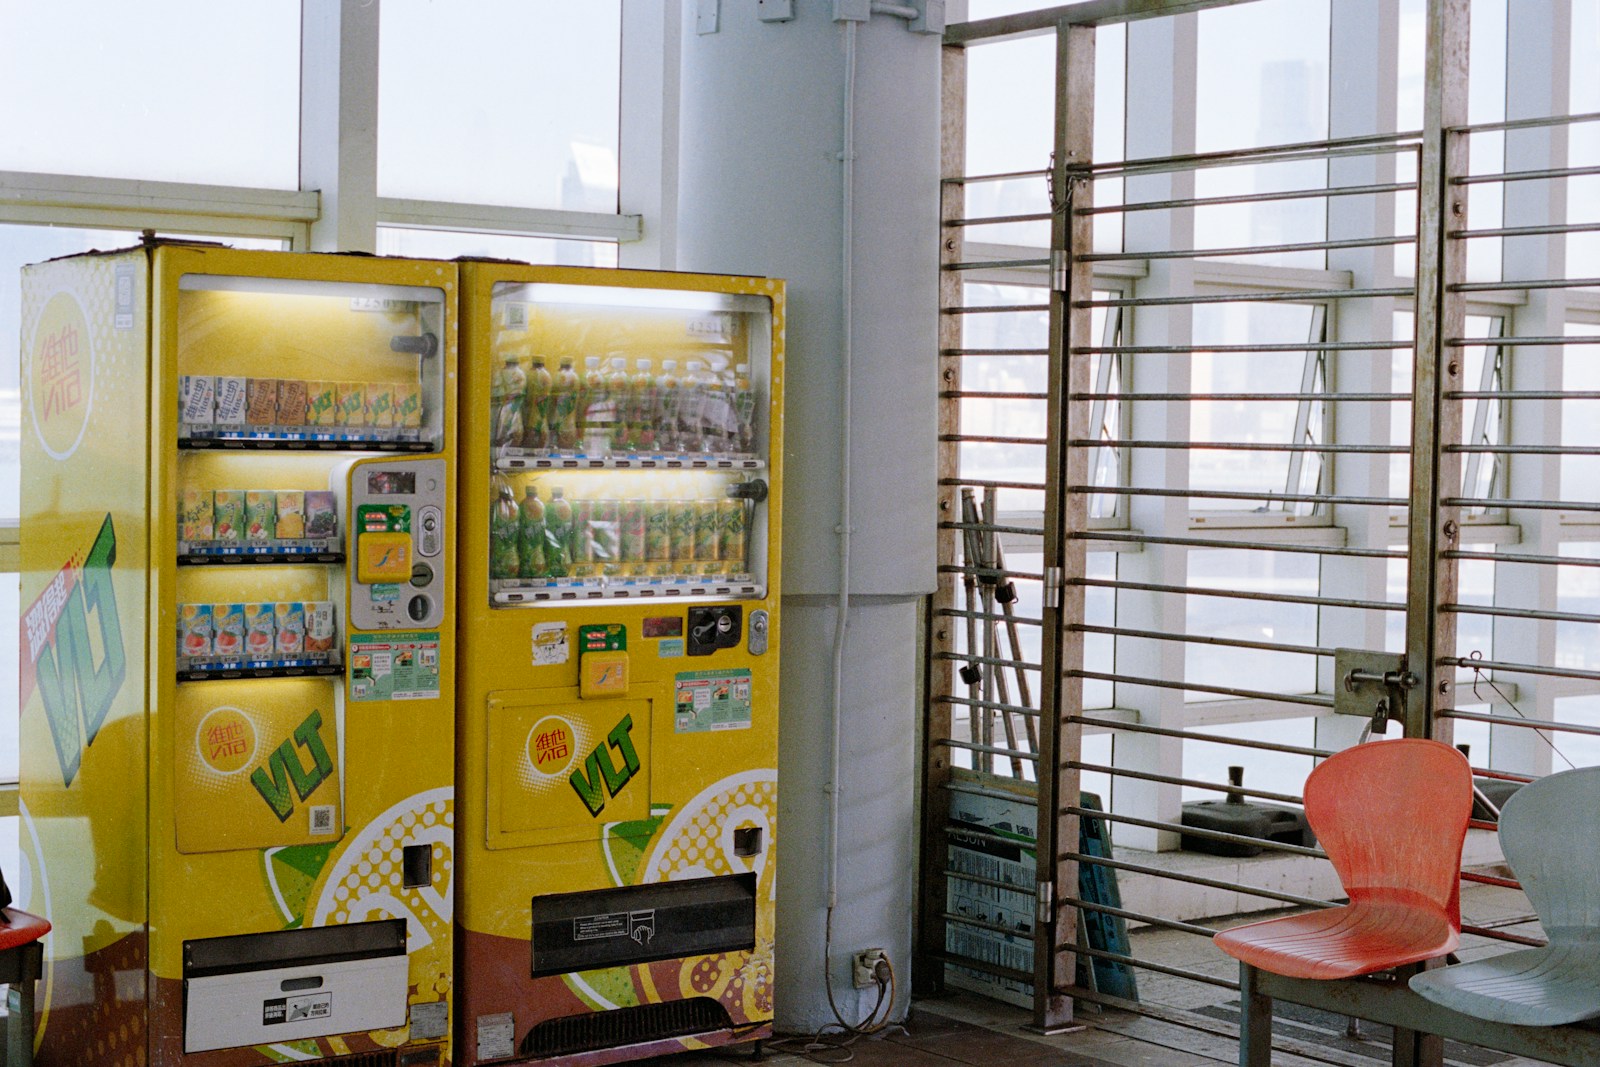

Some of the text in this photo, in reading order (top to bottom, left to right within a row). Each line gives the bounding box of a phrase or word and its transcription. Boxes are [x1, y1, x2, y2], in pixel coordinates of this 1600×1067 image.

[207, 721, 245, 746] 維他
[535, 728, 566, 754] 維他
[569, 712, 641, 819] VLT
